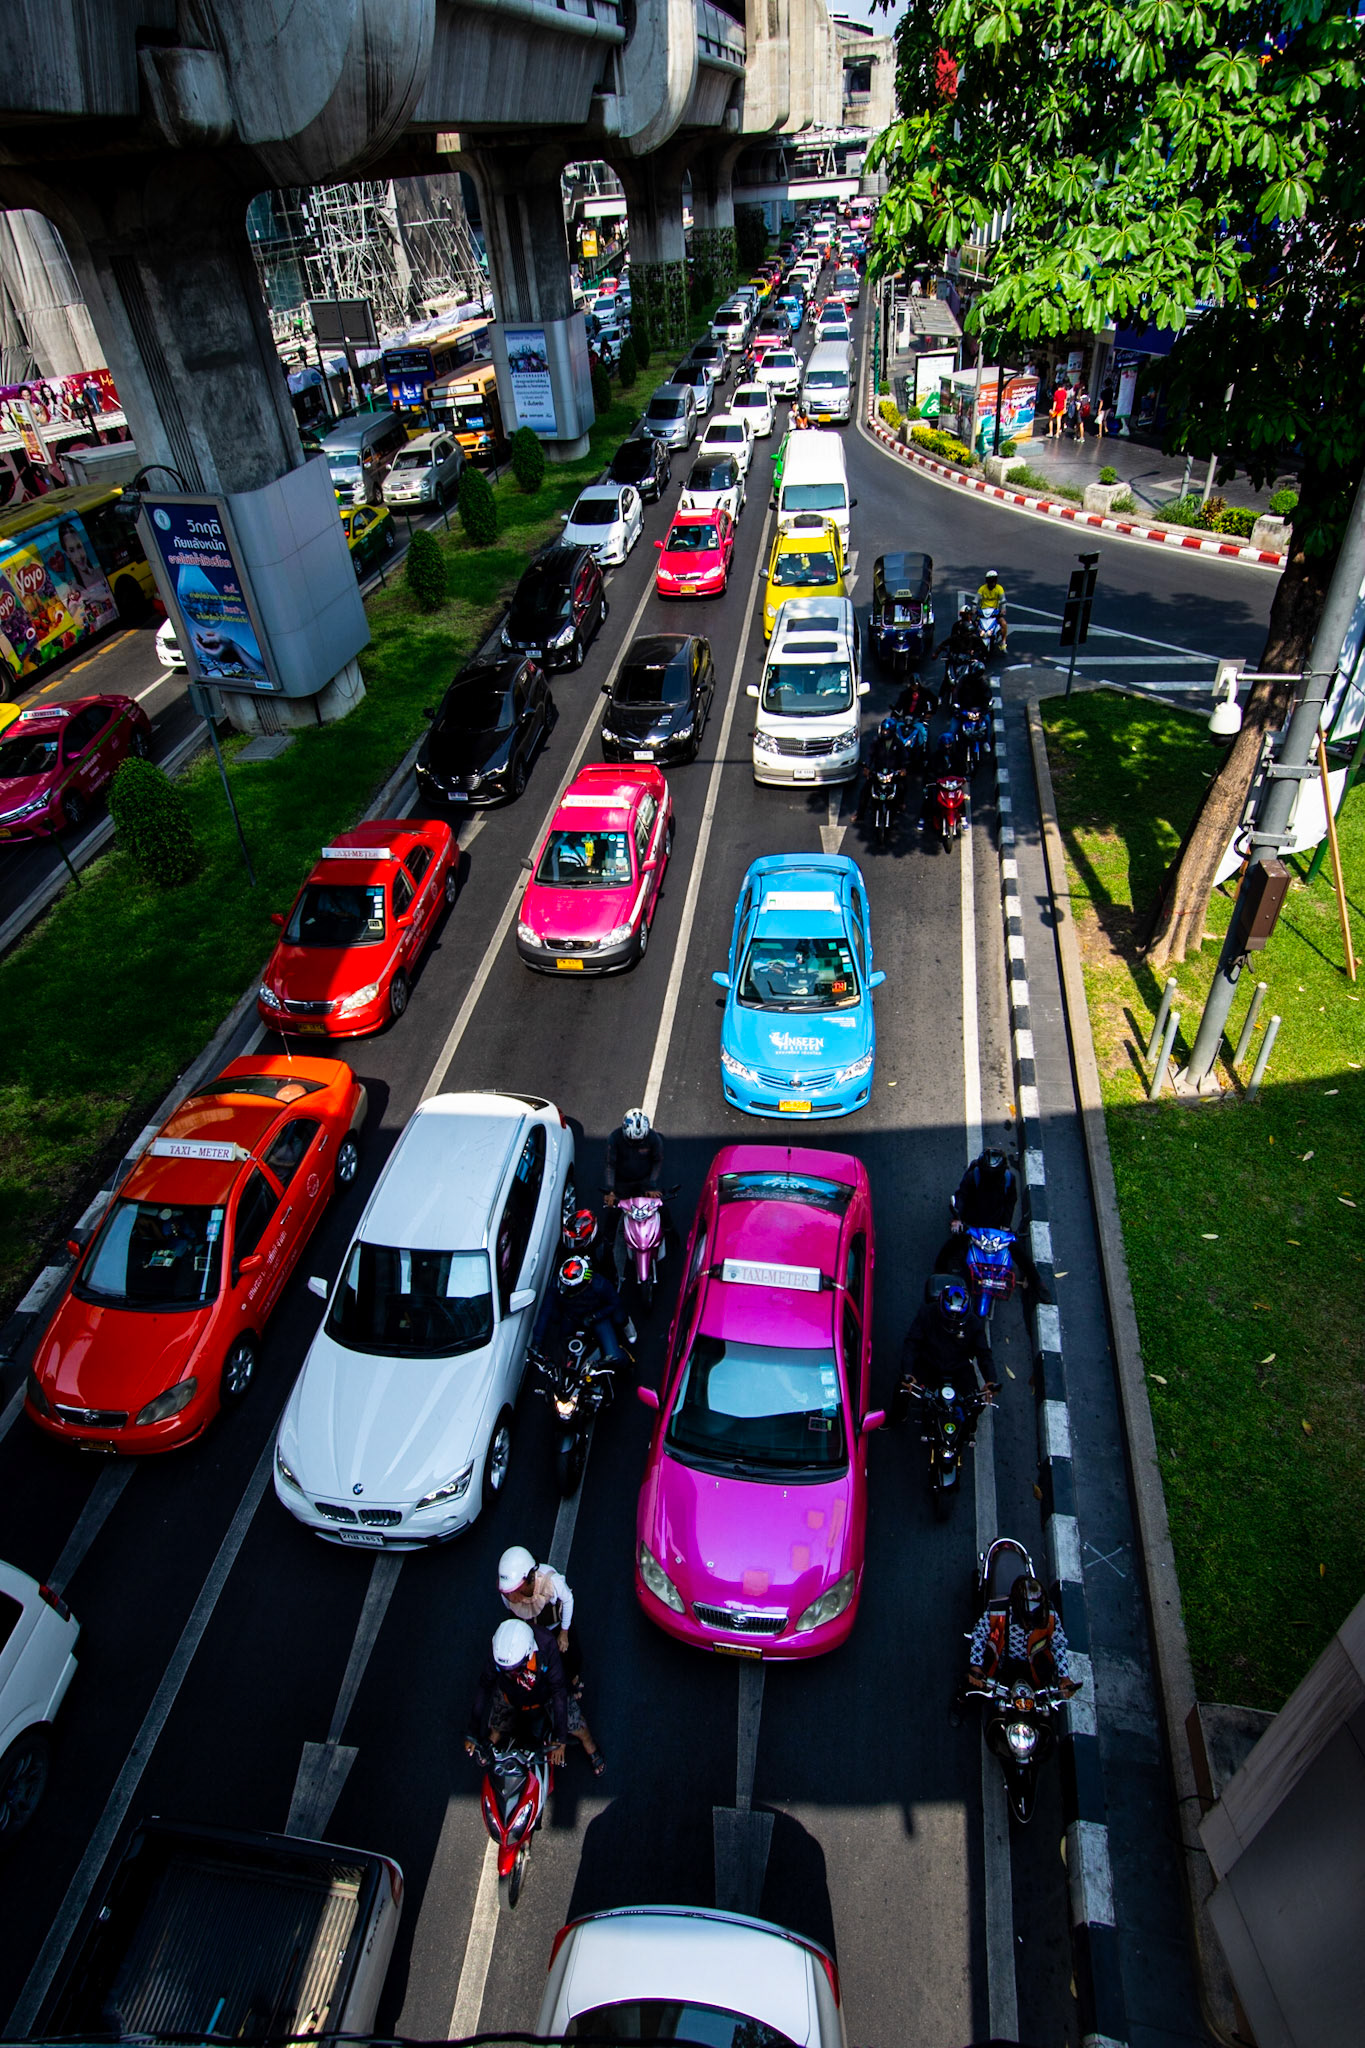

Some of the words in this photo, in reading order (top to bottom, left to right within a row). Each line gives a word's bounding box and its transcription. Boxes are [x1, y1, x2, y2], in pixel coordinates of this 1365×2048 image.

[187, 519, 221, 537] วิกฤติ
[173, 536, 227, 552] ภัยแล้งหนัก
[14, 567, 43, 598] Yoyo
[741, 1266, 809, 1288] TAXI-METER
